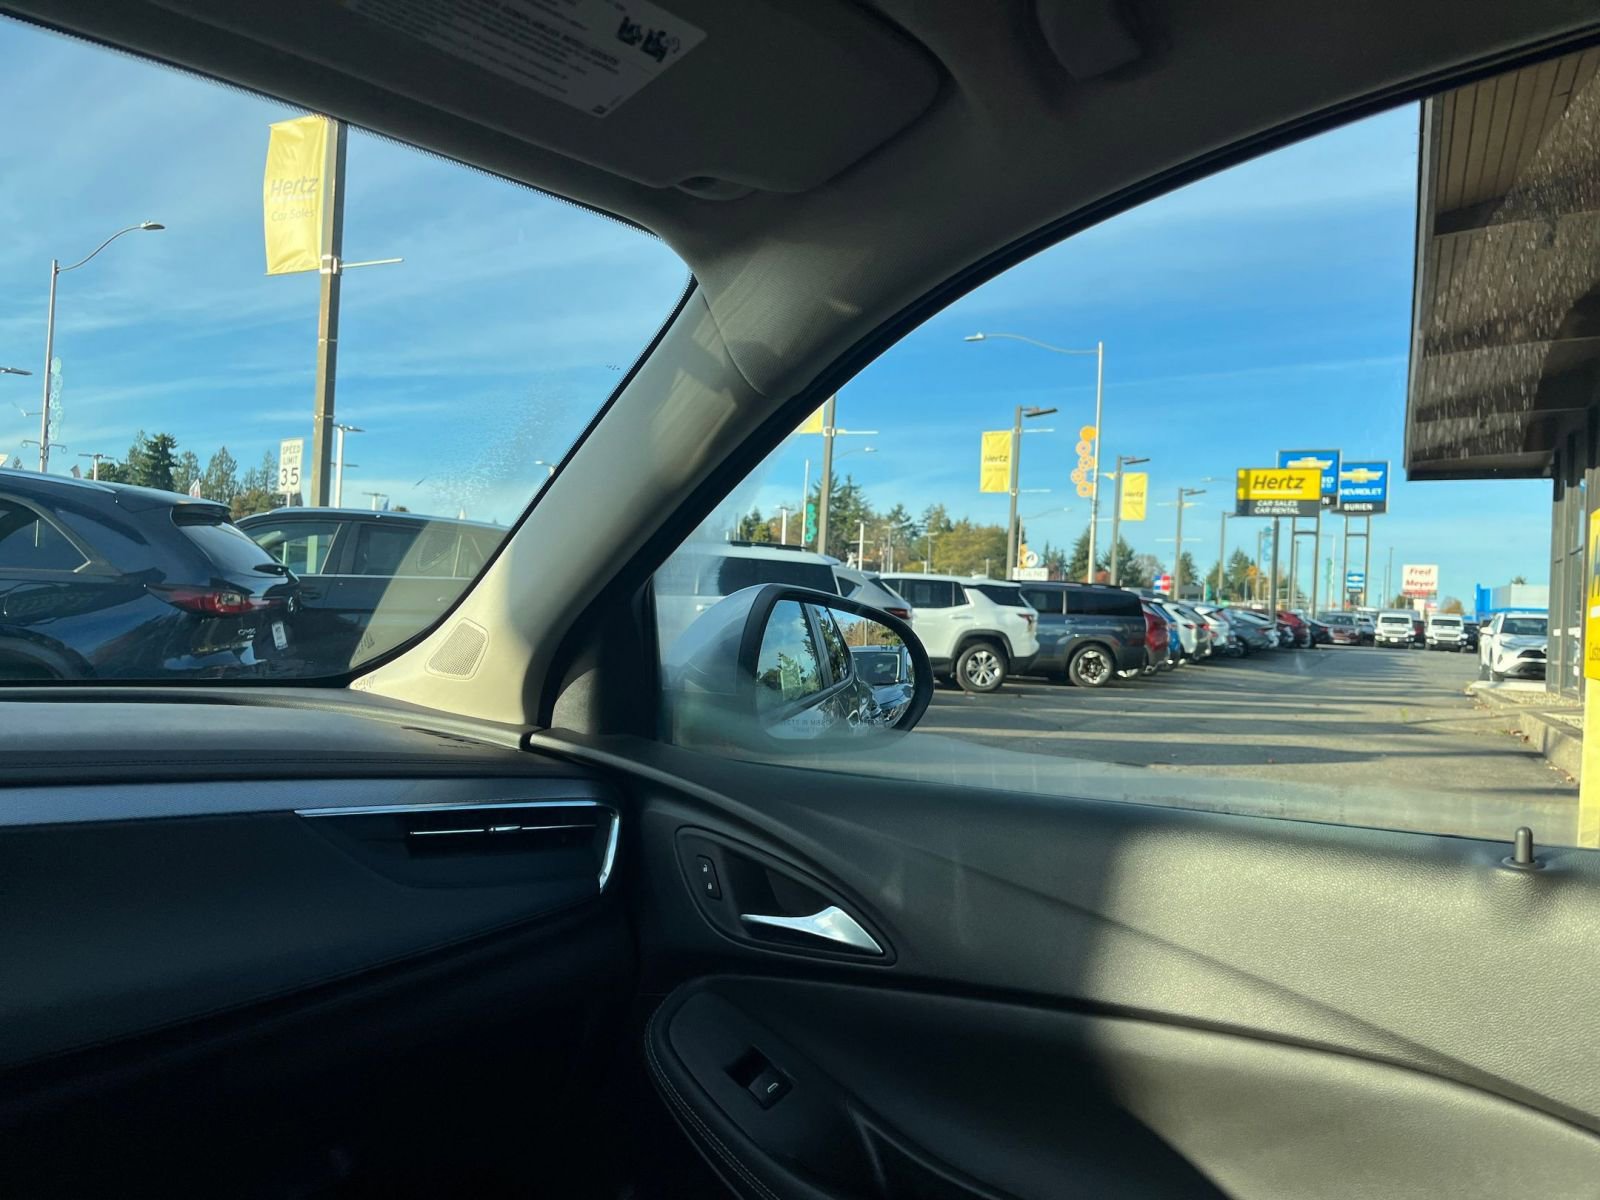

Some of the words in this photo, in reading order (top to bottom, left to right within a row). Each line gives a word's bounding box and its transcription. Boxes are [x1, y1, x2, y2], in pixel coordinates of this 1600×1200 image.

[270, 176, 319, 197] Hertz
[271, 210, 288, 222] Car
[290, 207, 315, 219] Sales
[282, 445, 301, 455] SPEED
[282, 455, 298, 466] LIMIT
[984, 454, 1008, 463] Hertz
[280, 467, 299, 487] 35
[1252, 475, 1306, 490] Hertz
[1340, 487, 1382, 496] HEVROLET
[1343, 503, 1373, 511] BURIEN
[1409, 567, 1432, 576] Fred
[1405, 579, 1434, 588] Meyer
